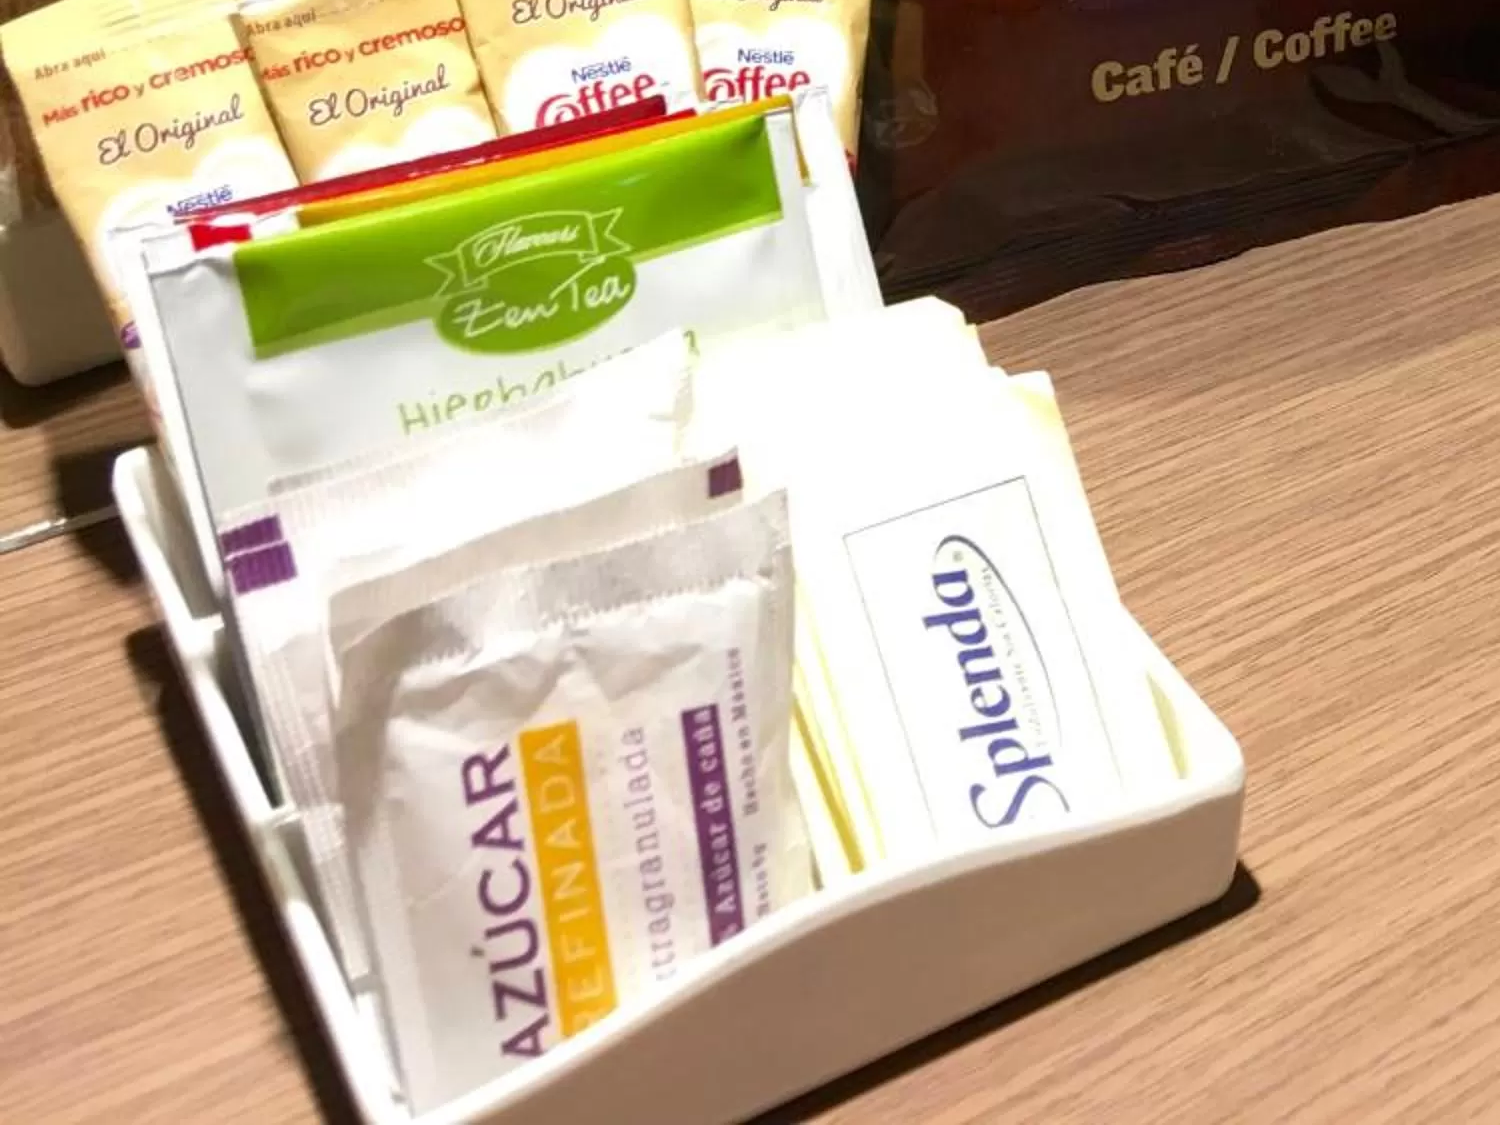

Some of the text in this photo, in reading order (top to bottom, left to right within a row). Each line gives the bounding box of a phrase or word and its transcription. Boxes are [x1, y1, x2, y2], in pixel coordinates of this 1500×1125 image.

[293, 48, 341, 74] rico
[344, 49, 355, 64] y
[358, 15, 467, 56] cremoso
[571, 57, 632, 84] Nestlé
[737, 47, 796, 66] Nestlé
[1091, 43, 1204, 104] Café
[1253, 5, 1398, 70] Coffee
[42, 103, 79, 127] Más
[80, 83, 131, 113] rico
[136, 83, 146, 98] y
[308, 62, 451, 127] El Original
[97, 93, 245, 165] El Original
[451, 255, 631, 339] Zen Tea
[921, 567, 1071, 830] Splenda
[701, 778, 725, 815] de
[459, 741, 551, 1059] AZÚCAR
